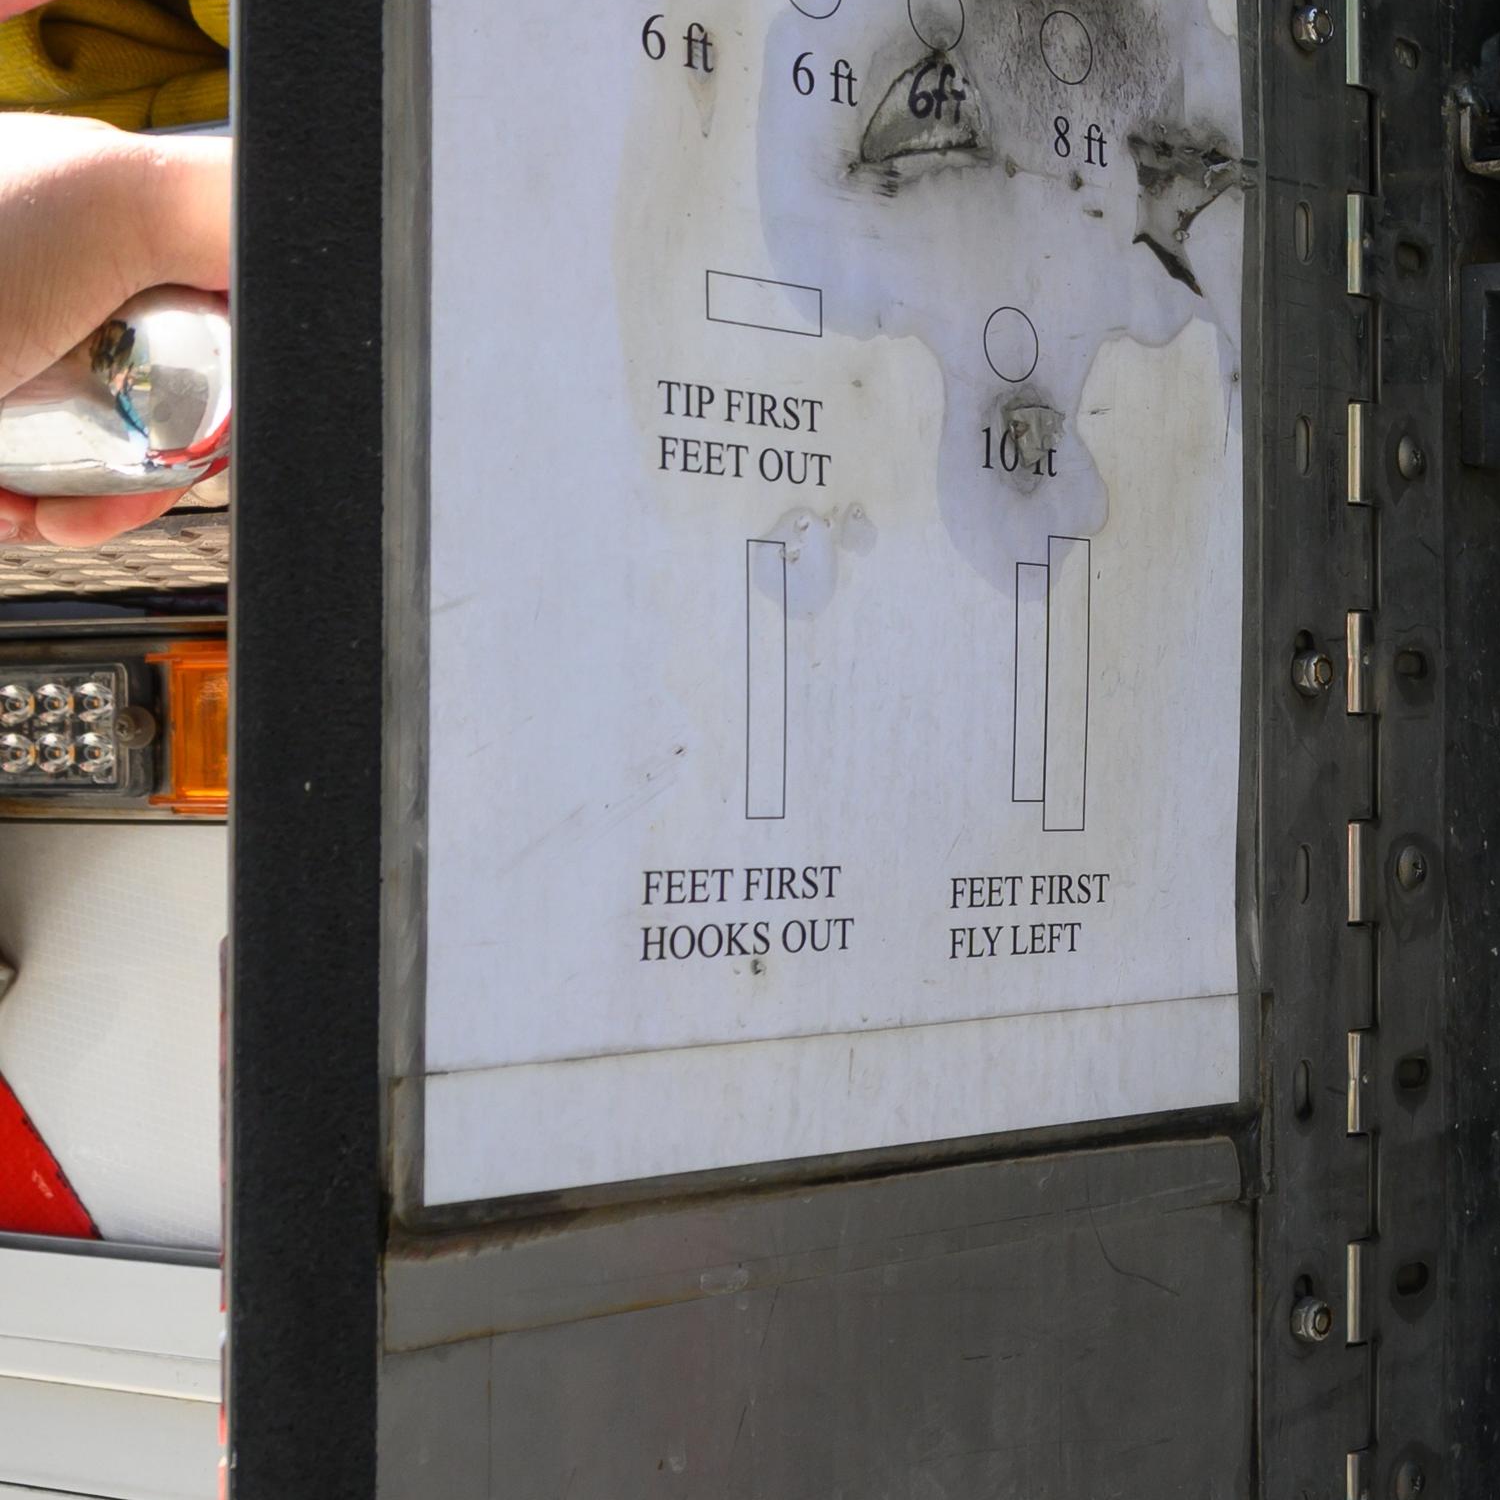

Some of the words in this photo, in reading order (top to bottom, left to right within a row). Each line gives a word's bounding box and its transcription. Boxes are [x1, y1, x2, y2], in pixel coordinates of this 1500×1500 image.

[641, 13, 667, 61] 6
[682, 22, 715, 74] ft
[792, 51, 815, 96] 6
[829, 58, 858, 108] ft
[1053, 115, 1071, 158] 8
[1083, 123, 1109, 168] ft
[657, 379, 716, 420] TIP
[724, 388, 824, 434] FIRST
[657, 435, 750, 479] FEET
[758, 446, 832, 488] OUT
[981, 426, 1022, 473] 10
[642, 868, 735, 906] FEET
[742, 865, 842, 903] FIRST
[949, 875, 1024, 909] FEET
[1029, 873, 1111, 907] FIRST
[639, 920, 771, 962] HOOKS
[781, 917, 855, 955] OUT
[948, 925, 1005, 960] FLY
[1010, 922, 1082, 956] LEFT
